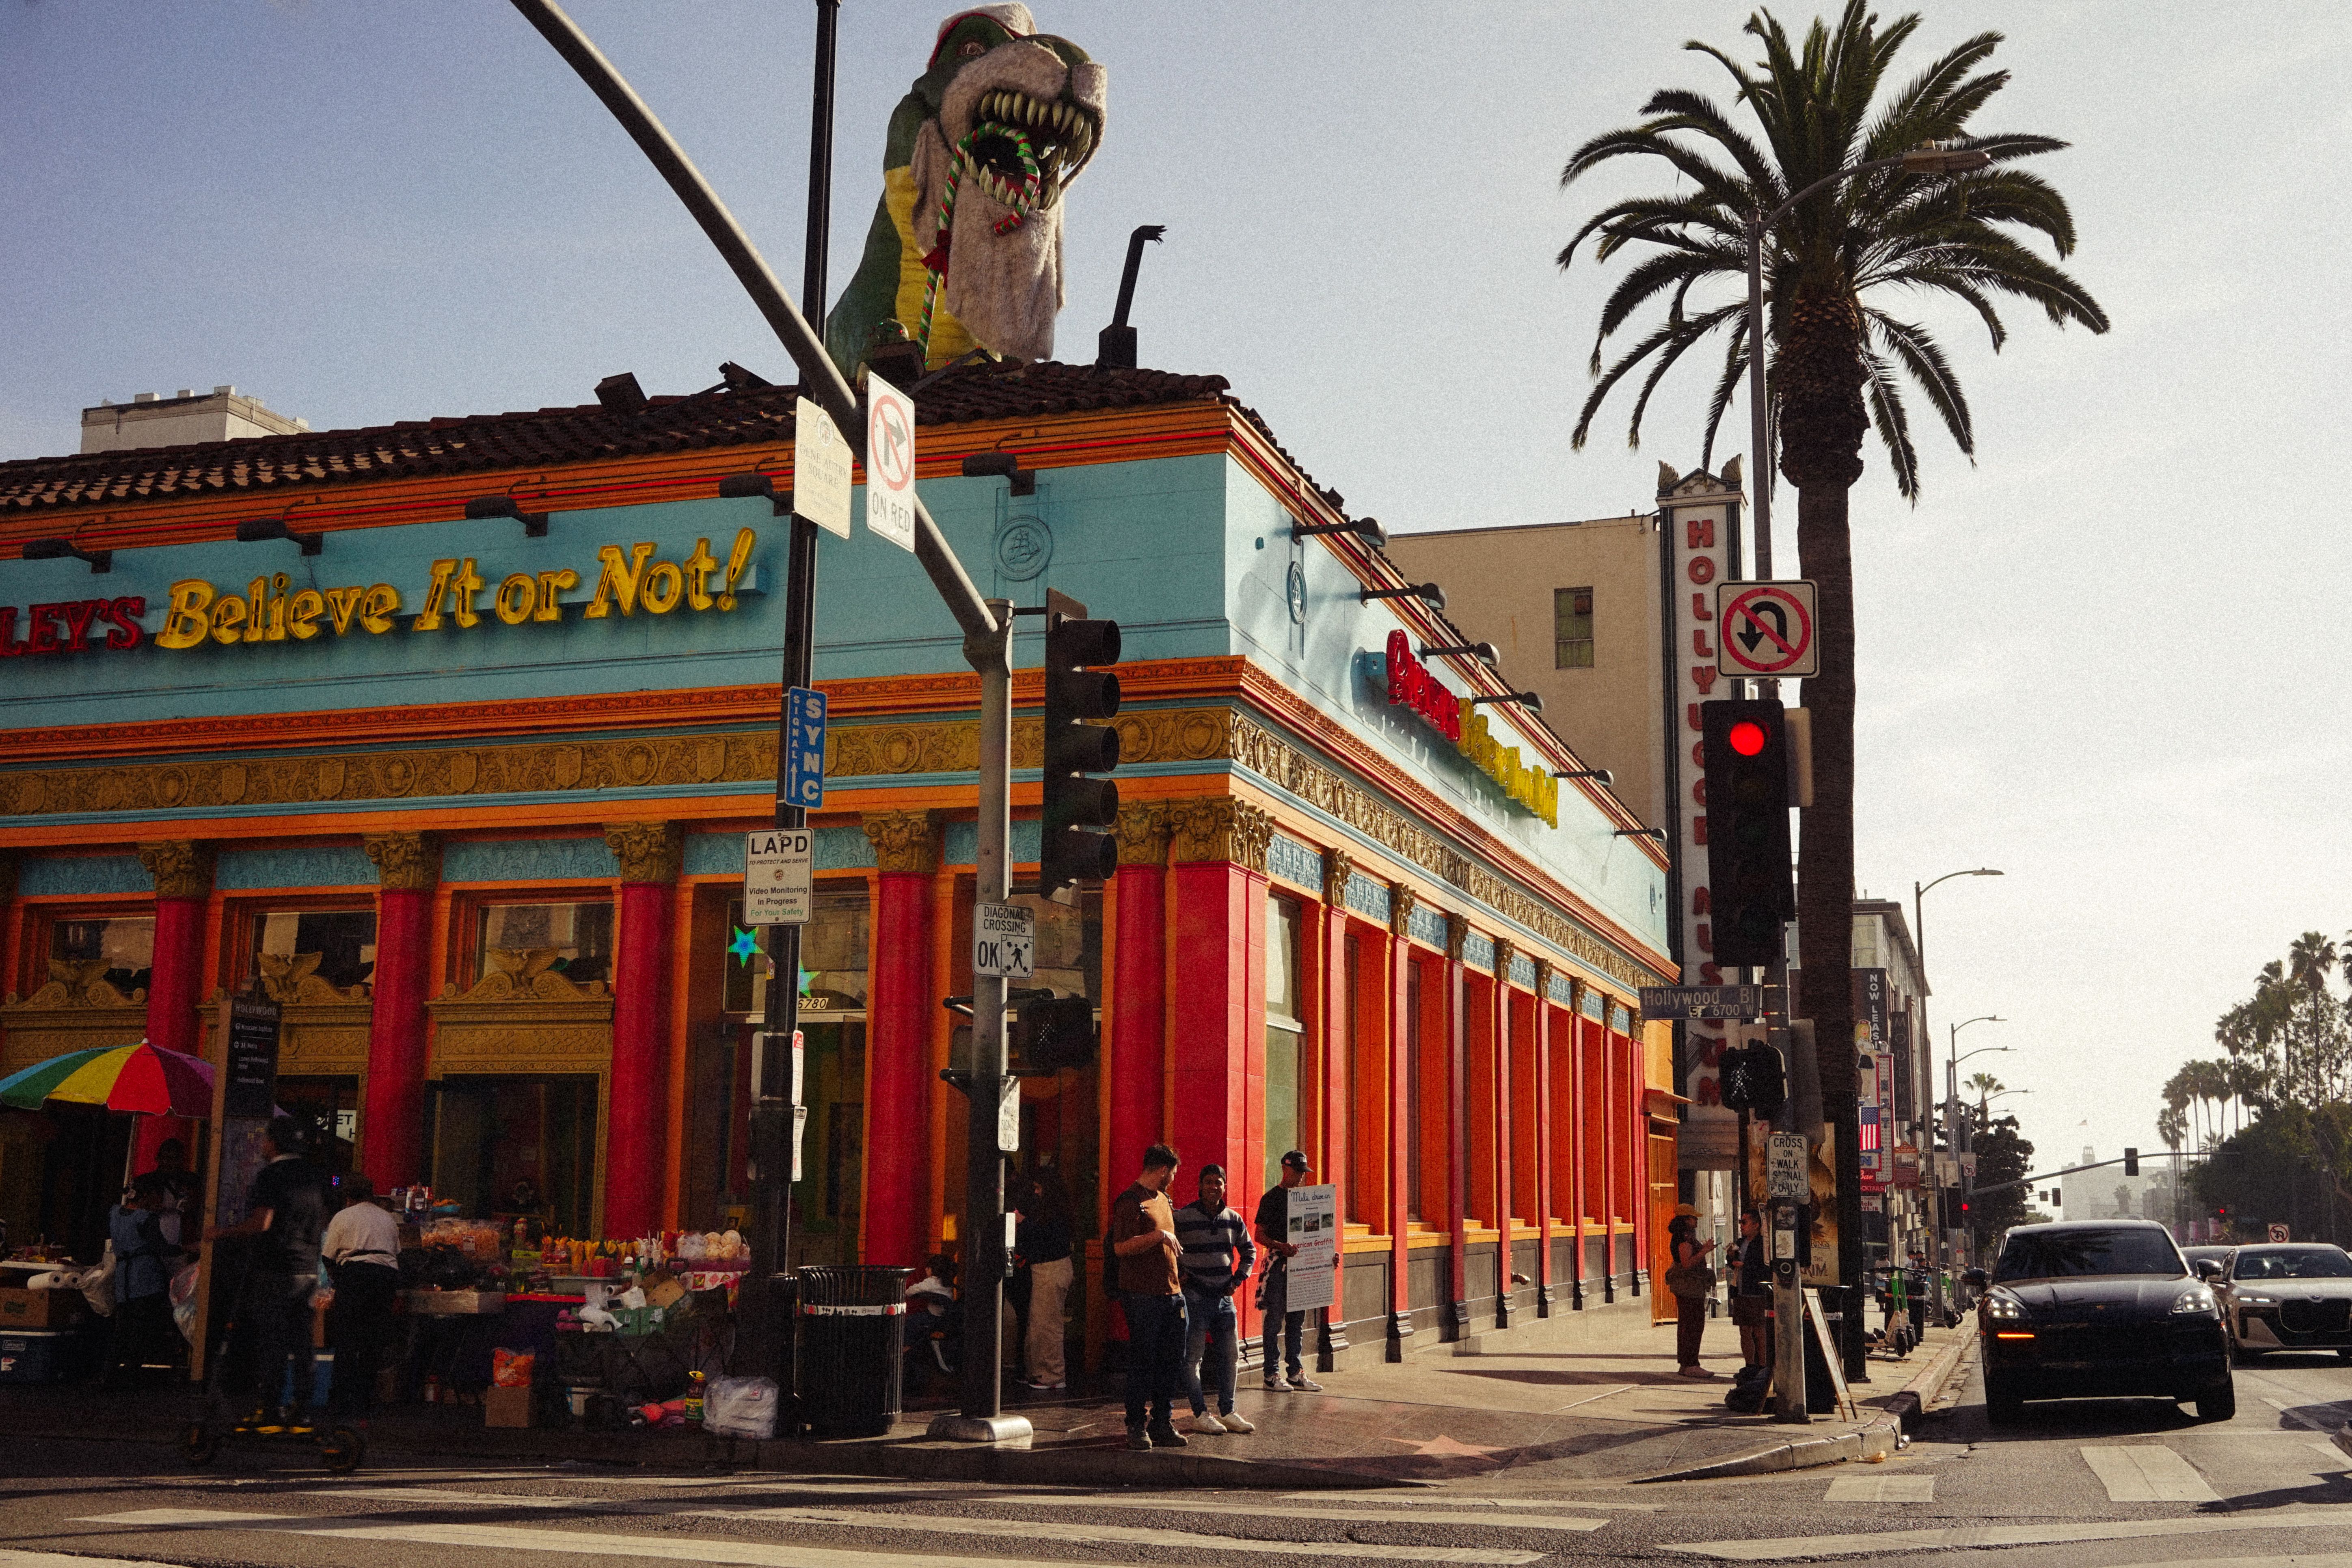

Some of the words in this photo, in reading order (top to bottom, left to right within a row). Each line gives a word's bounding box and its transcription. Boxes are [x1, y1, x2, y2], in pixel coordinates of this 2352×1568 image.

[800, 444, 821, 464] GENE
[824, 458, 848, 479] AUTRY
[808, 463, 839, 489] SQUARE
[872, 491, 887, 520] ON
[892, 502, 910, 532] RED
[154, 572, 403, 649] Believe
[413, 557, 484, 632] It
[495, 569, 580, 625] or
[584, 527, 757, 620] Not!
[791, 695, 800, 759] SIGNAL
[802, 698, 821, 801] SYNC
[751, 836, 808, 855] LAPD
[782, 908, 803, 916] Safety
[983, 919, 1026, 933] CROSSING
[978, 941, 999, 968] OK
[1693, 886, 1726, 1107] MUSUM
[1869, 974, 1880, 1000] NOW
[798, 999, 826, 1009] 6780
[1644, 988, 1719, 1009] Hollywood
[1740, 987, 1754, 1004] Bl
[235, 1004, 276, 1015] HOLLYWOOD
[1713, 1004, 1740, 1016] 6700
[1746, 1004, 1754, 1015] W
[1872, 1005, 1880, 1049] LEASI
[1774, 1138, 1802, 1148] CROSS
[1777, 1159, 1799, 1169] WALK
[1773, 1171, 1803, 1181] SNAL
[1291, 1191, 1310, 1202] Mels
[1314, 1238, 1334, 1246] Graffiti
